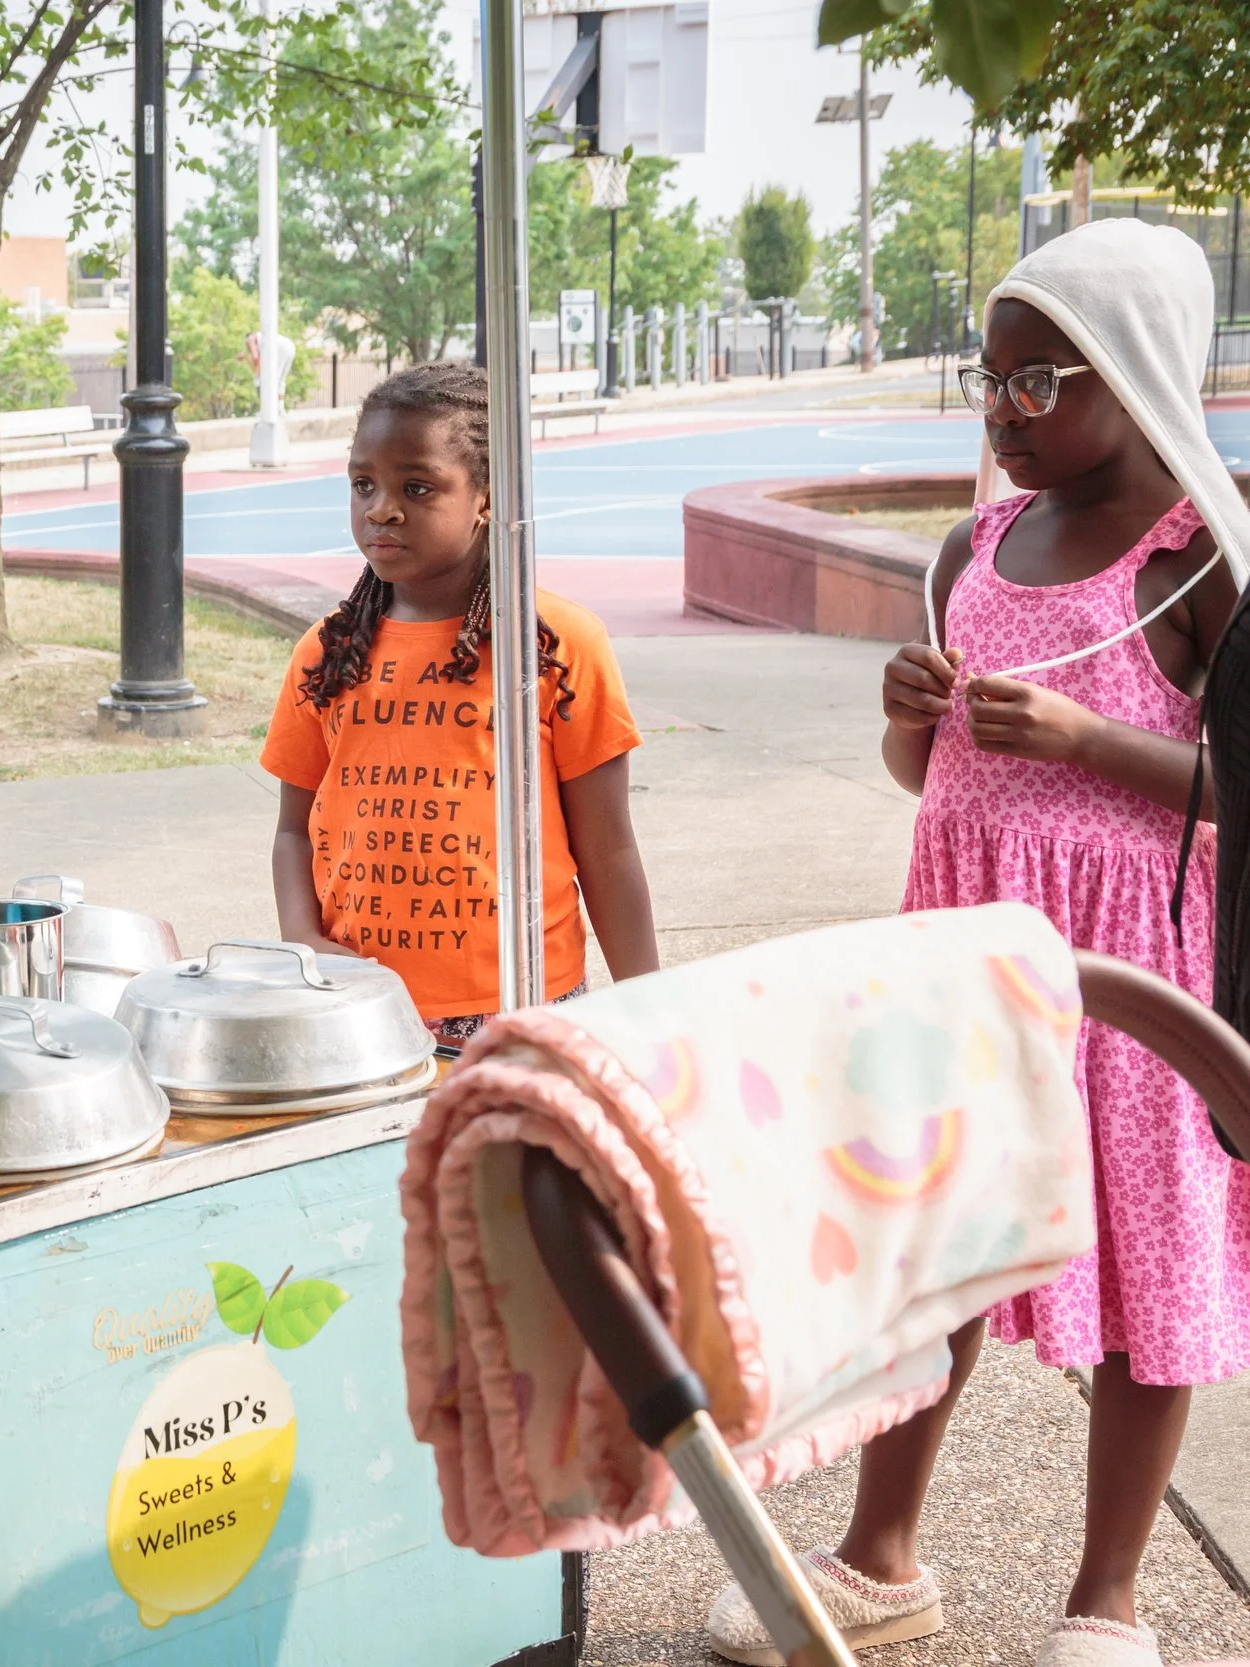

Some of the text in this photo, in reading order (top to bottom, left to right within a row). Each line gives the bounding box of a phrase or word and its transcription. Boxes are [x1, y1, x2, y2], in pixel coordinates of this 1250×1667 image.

[358, 661, 397, 685] BE
[340, 765, 496, 791] EXEMPLIFY
[357, 798, 462, 821] CHRIST
[342, 830, 491, 860] IN SPEECH,
[338, 861, 489, 890] CONDUCT,
[331, 891, 392, 920] LOVE,
[360, 927, 468, 950] PURITY
[93, 1286, 213, 1351] Quality
[143, 1417, 215, 1460] Miss
[139, 1461, 236, 1515] Sweets &
[137, 1509, 237, 1558] Wellness
